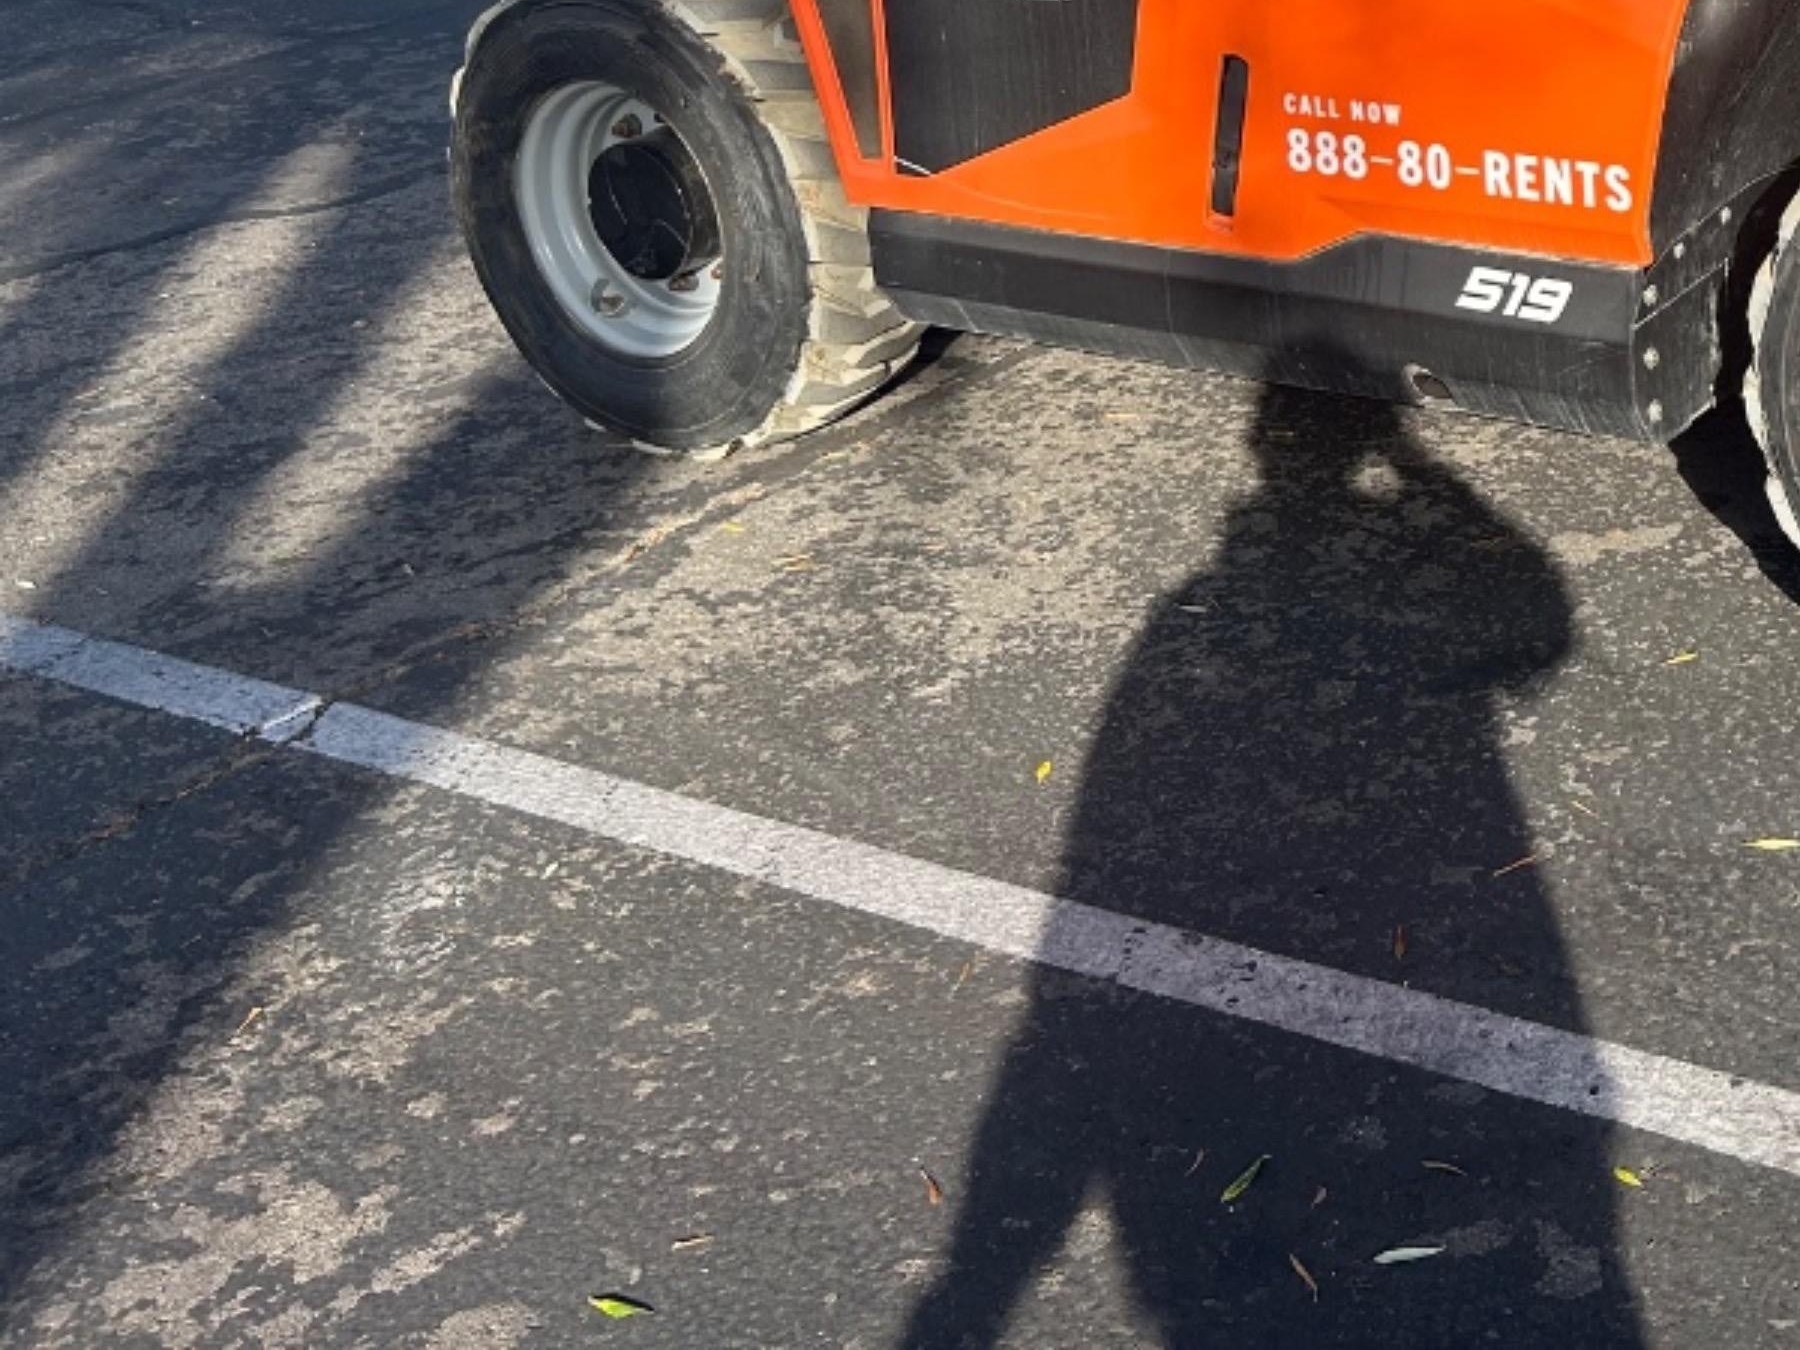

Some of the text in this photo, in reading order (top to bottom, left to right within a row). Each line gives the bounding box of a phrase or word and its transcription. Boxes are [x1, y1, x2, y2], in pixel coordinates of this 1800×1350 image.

[1283, 92, 1402, 126] CALL NOW
[1286, 127, 1634, 212] 888-80-RENTS
[1454, 265, 1574, 325] 519
